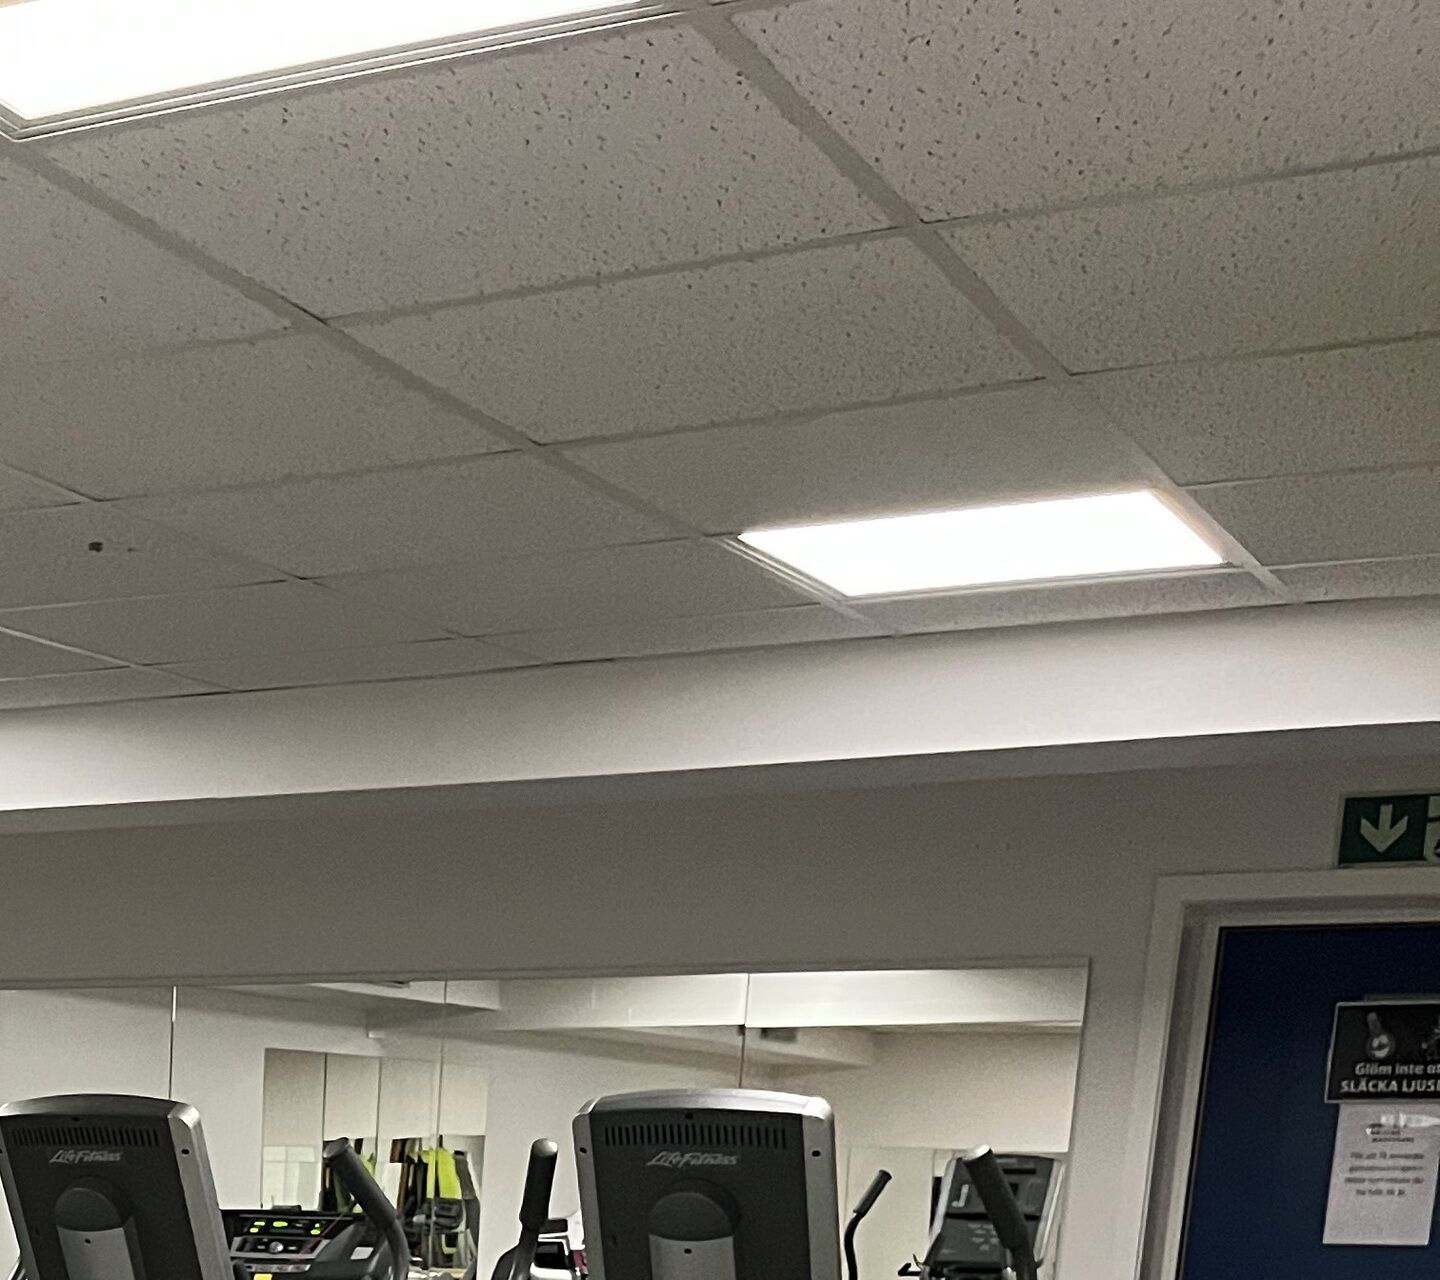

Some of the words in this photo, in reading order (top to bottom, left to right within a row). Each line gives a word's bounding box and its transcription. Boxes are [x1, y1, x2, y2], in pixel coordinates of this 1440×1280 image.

[1354, 1062, 1392, 1075] Glöm
[1395, 1062, 1424, 1075] inte
[1340, 1077, 1398, 1093] SLÄCKA
